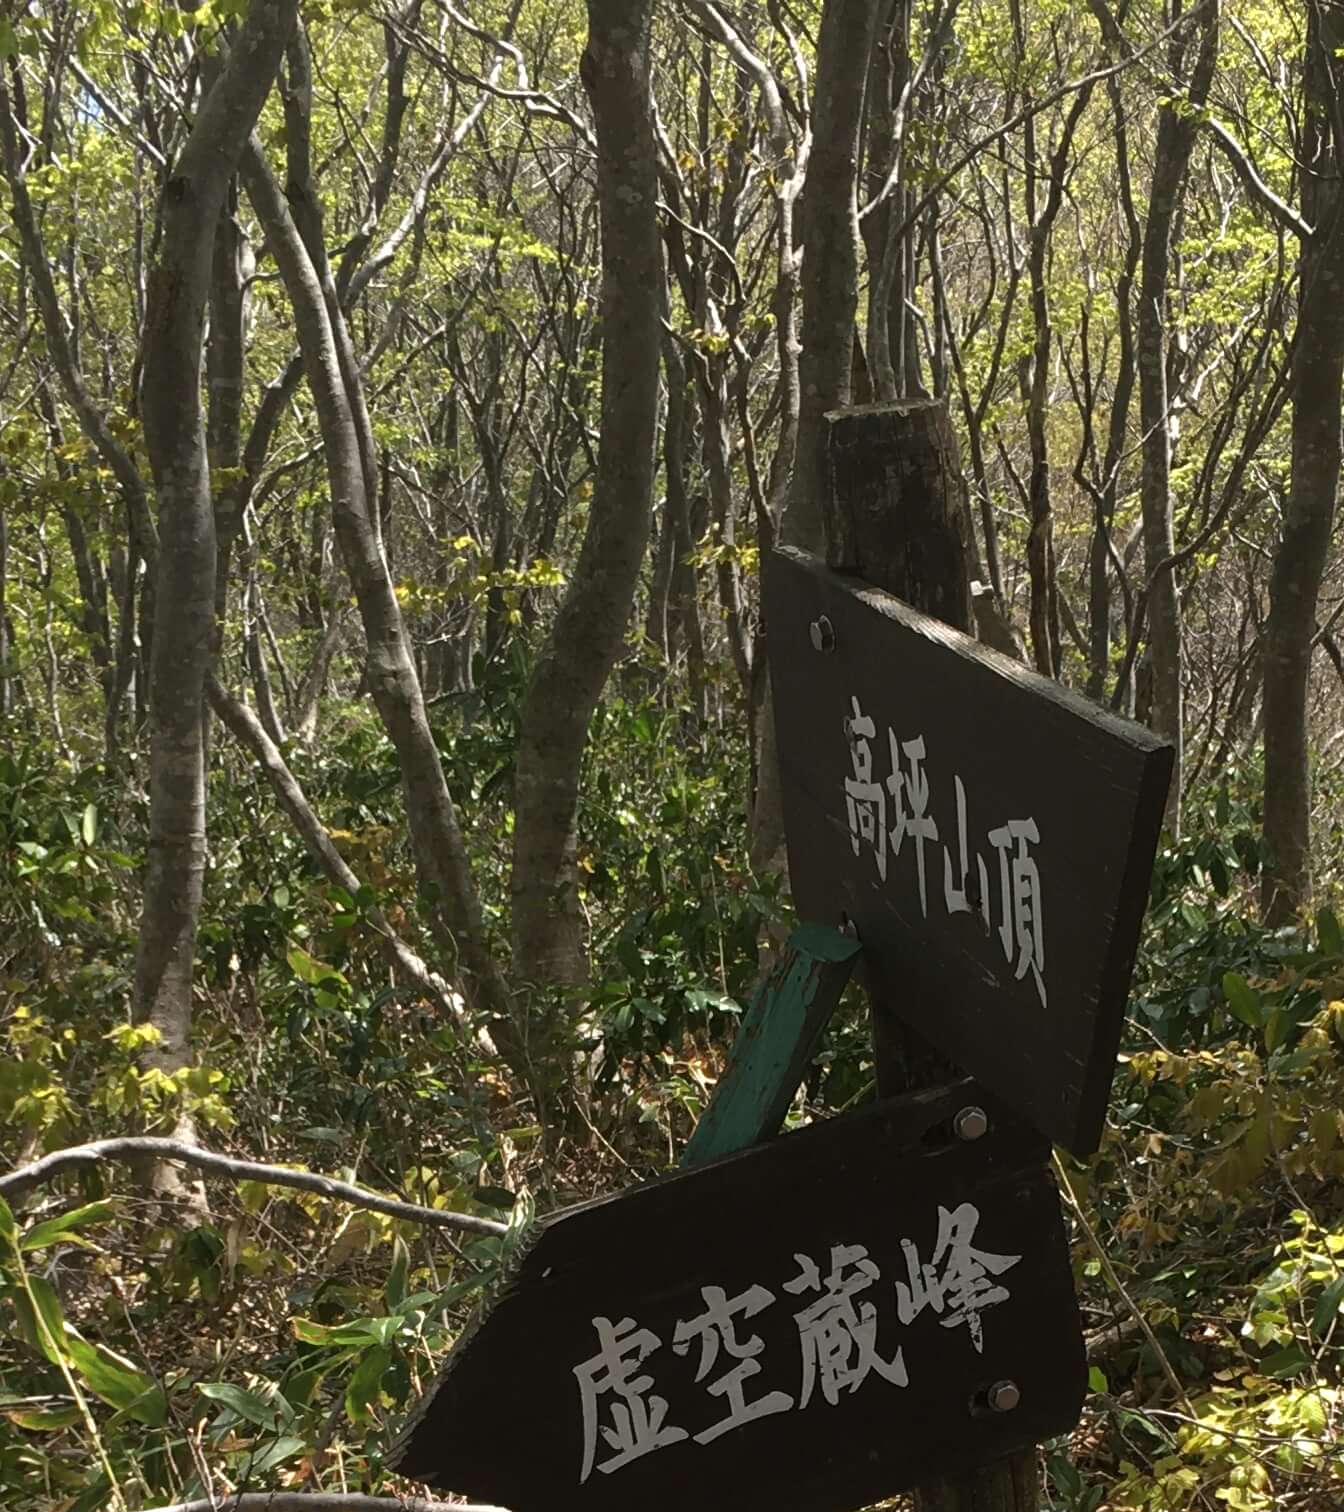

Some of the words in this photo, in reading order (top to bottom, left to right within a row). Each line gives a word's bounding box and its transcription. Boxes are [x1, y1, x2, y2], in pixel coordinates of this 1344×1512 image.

[843, 696, 1047, 1008] 高坪山頂
[572, 1203, 1022, 1484] 虚空蔵峰
